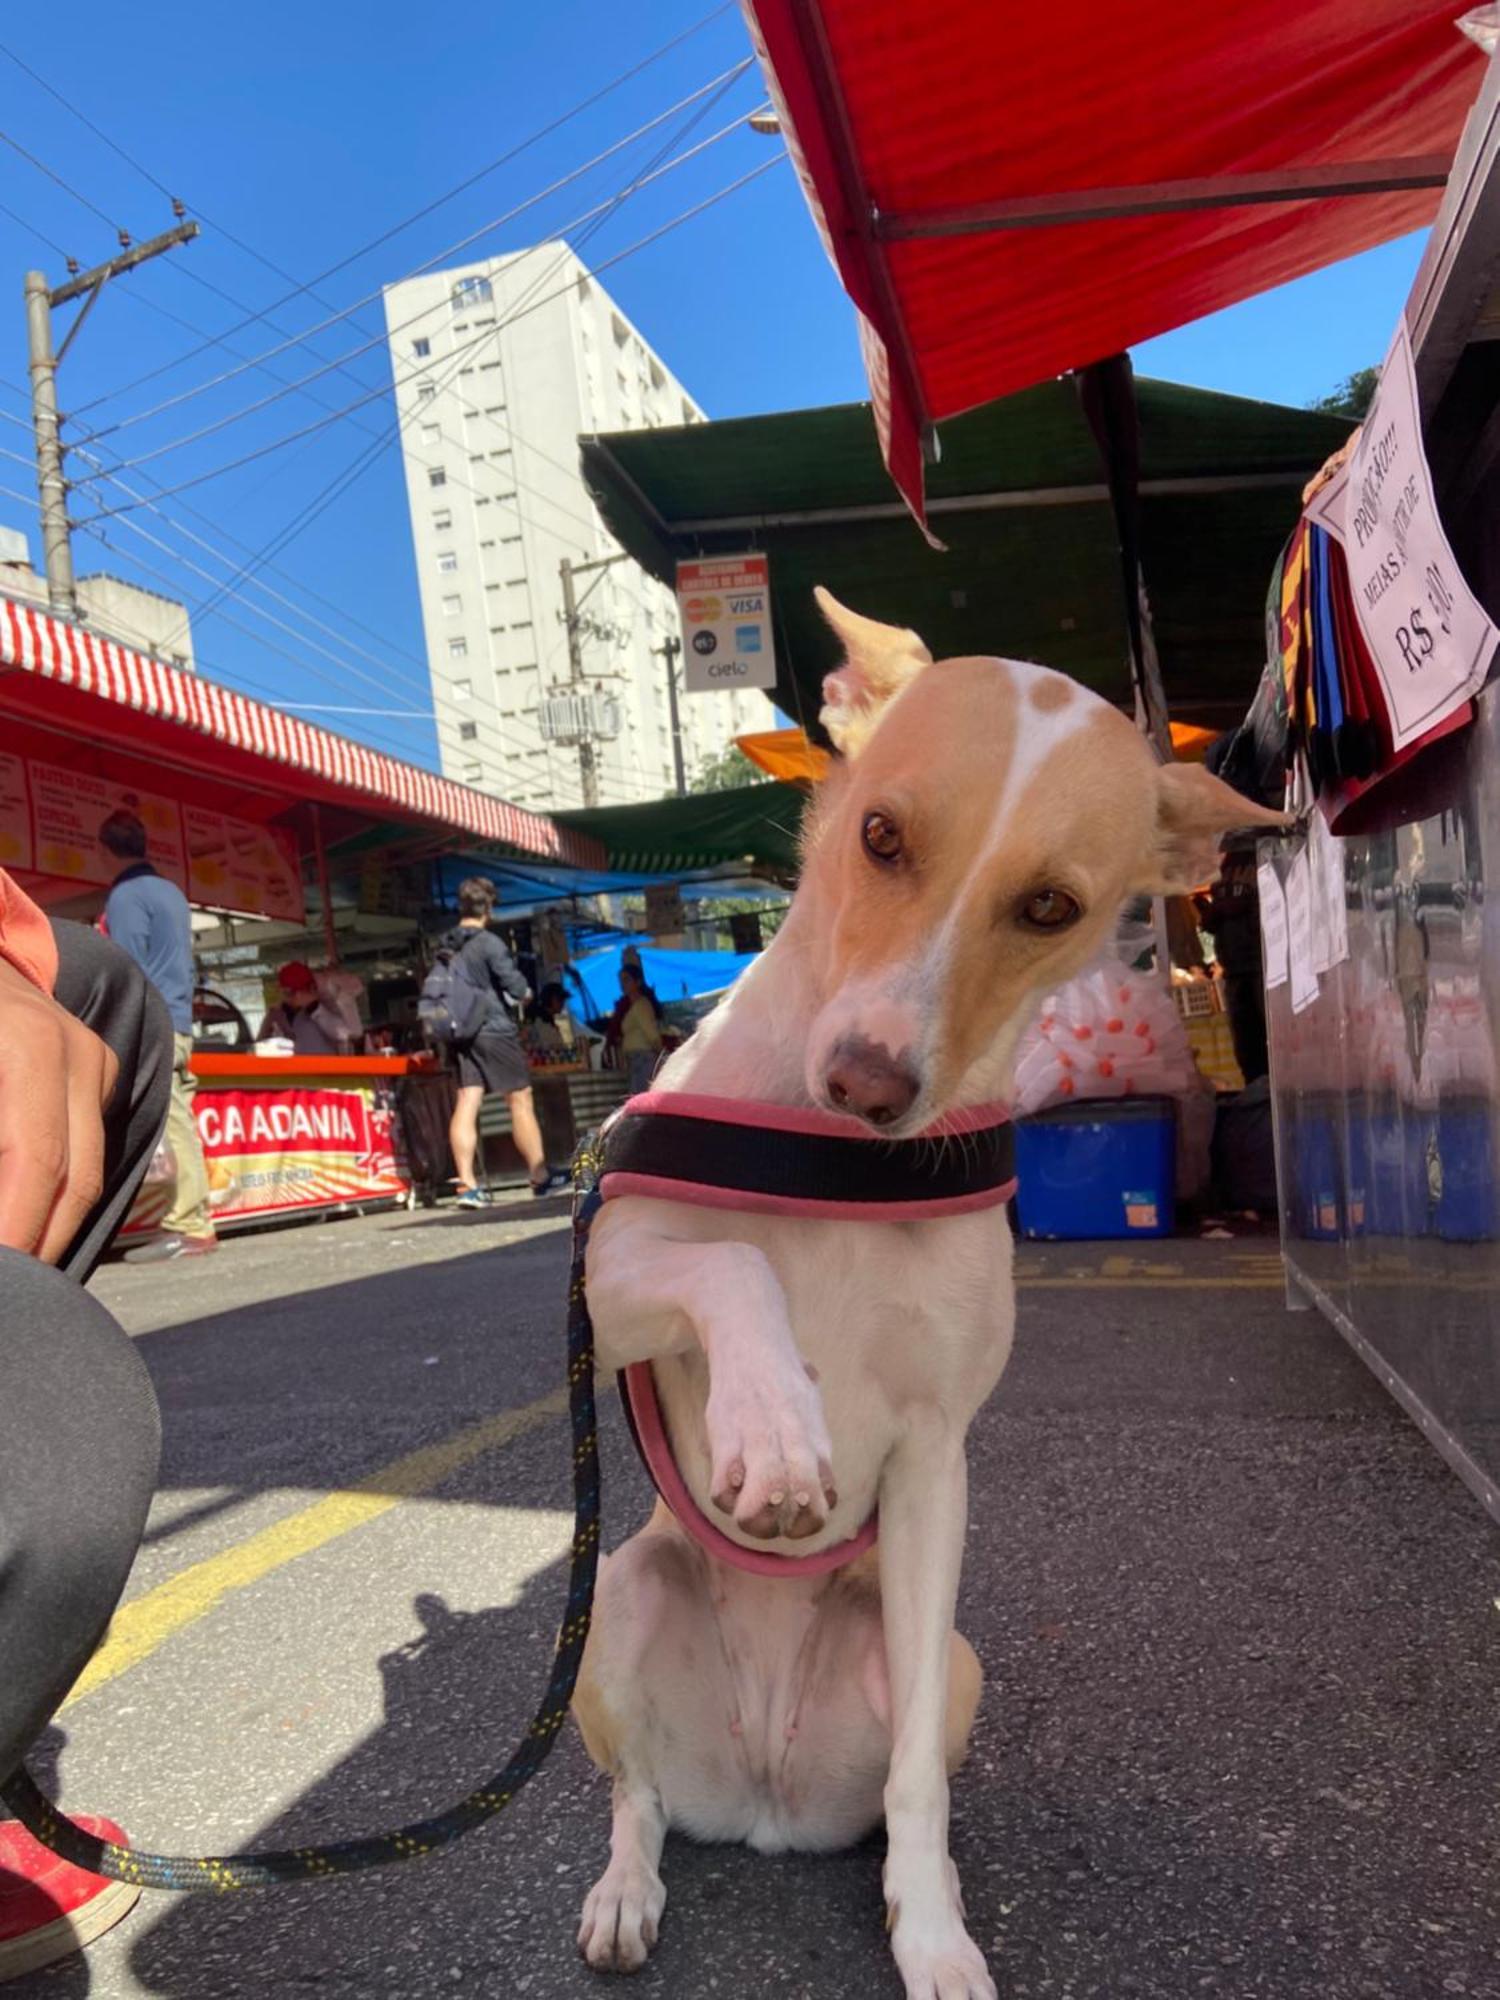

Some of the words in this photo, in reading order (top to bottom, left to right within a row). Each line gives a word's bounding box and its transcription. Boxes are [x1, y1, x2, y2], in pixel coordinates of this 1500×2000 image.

[1363, 552, 1401, 610] MEIAS
[730, 598, 763, 614] VISA
[1395, 607, 1434, 672] R$
[708, 662, 748, 677] cielo
